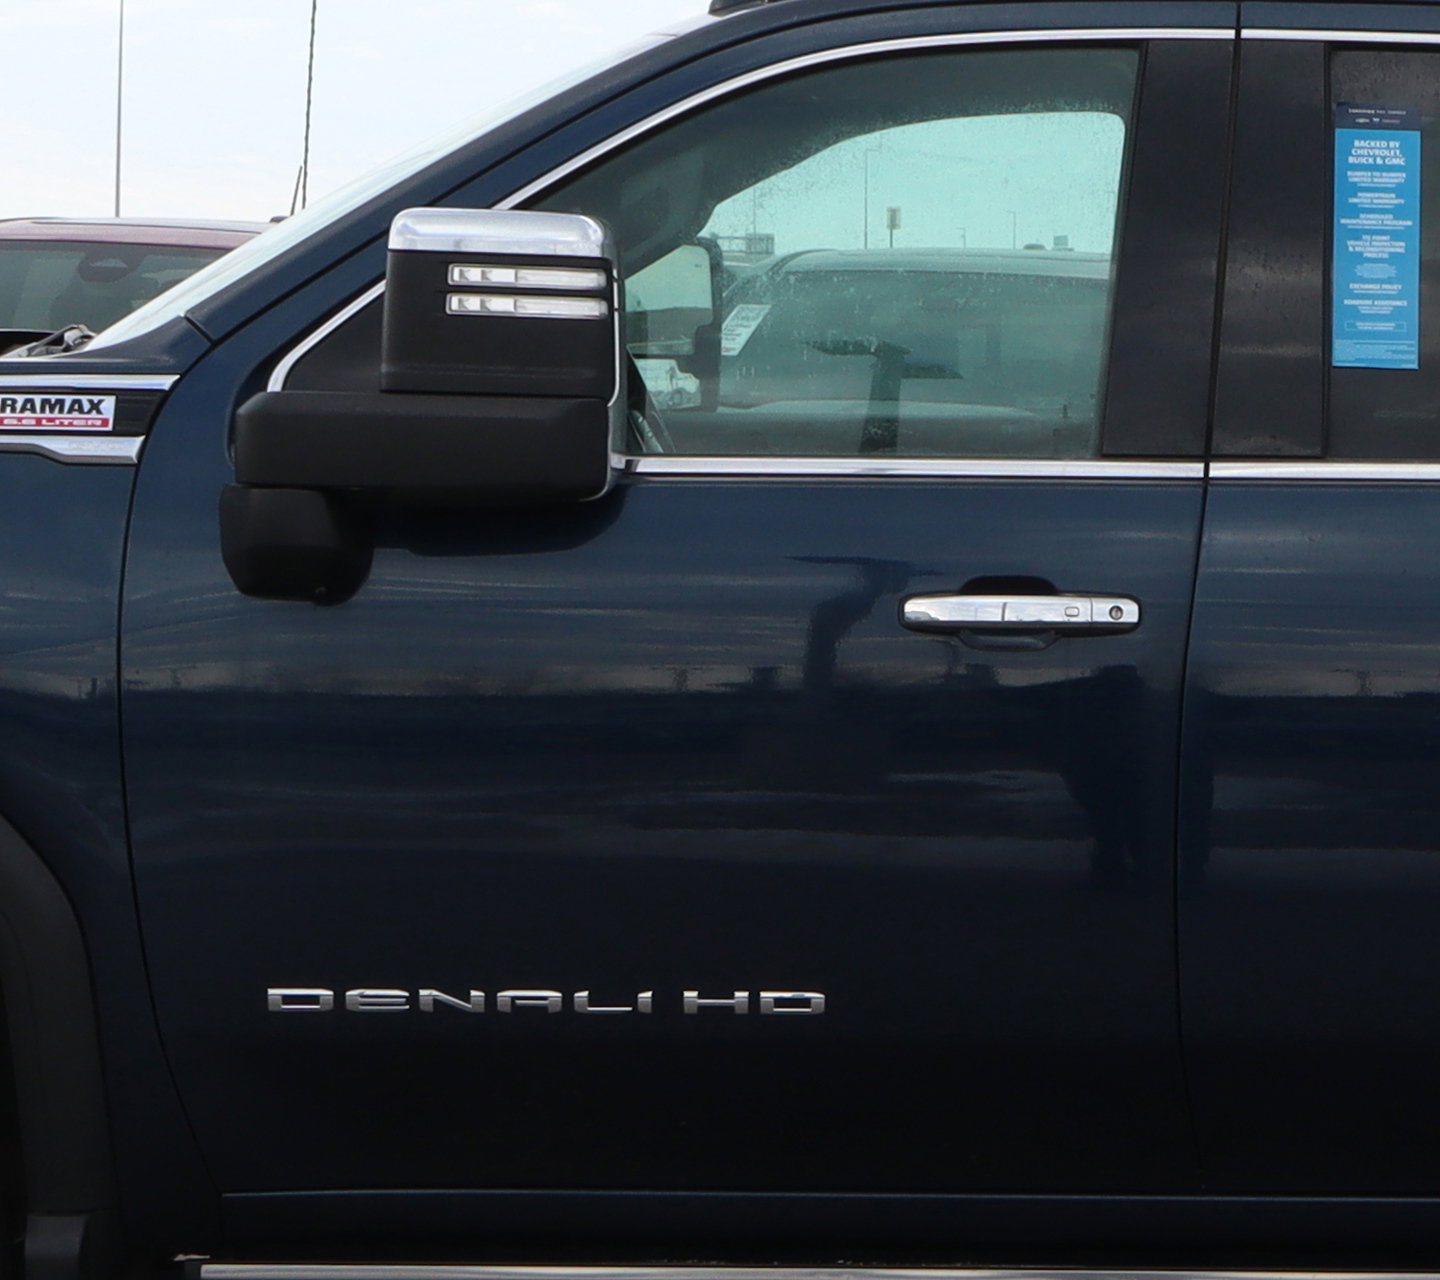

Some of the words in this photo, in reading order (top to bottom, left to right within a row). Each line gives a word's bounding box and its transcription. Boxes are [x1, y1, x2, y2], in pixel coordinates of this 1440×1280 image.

[1354, 140, 1388, 148] BACKED
[1389, 141, 1400, 149] BY
[1351, 148, 1403, 157] CHEVROLET,
[1348, 156, 1375, 164] BUICK
[1376, 157, 1384, 165] &
[1384, 157, 1406, 166] GMC
[3, 418, 37, 426] 6.6
[41, 418, 103, 427] LITER
[267, 988, 653, 1015] DENALI
[683, 990, 826, 1016] HD
